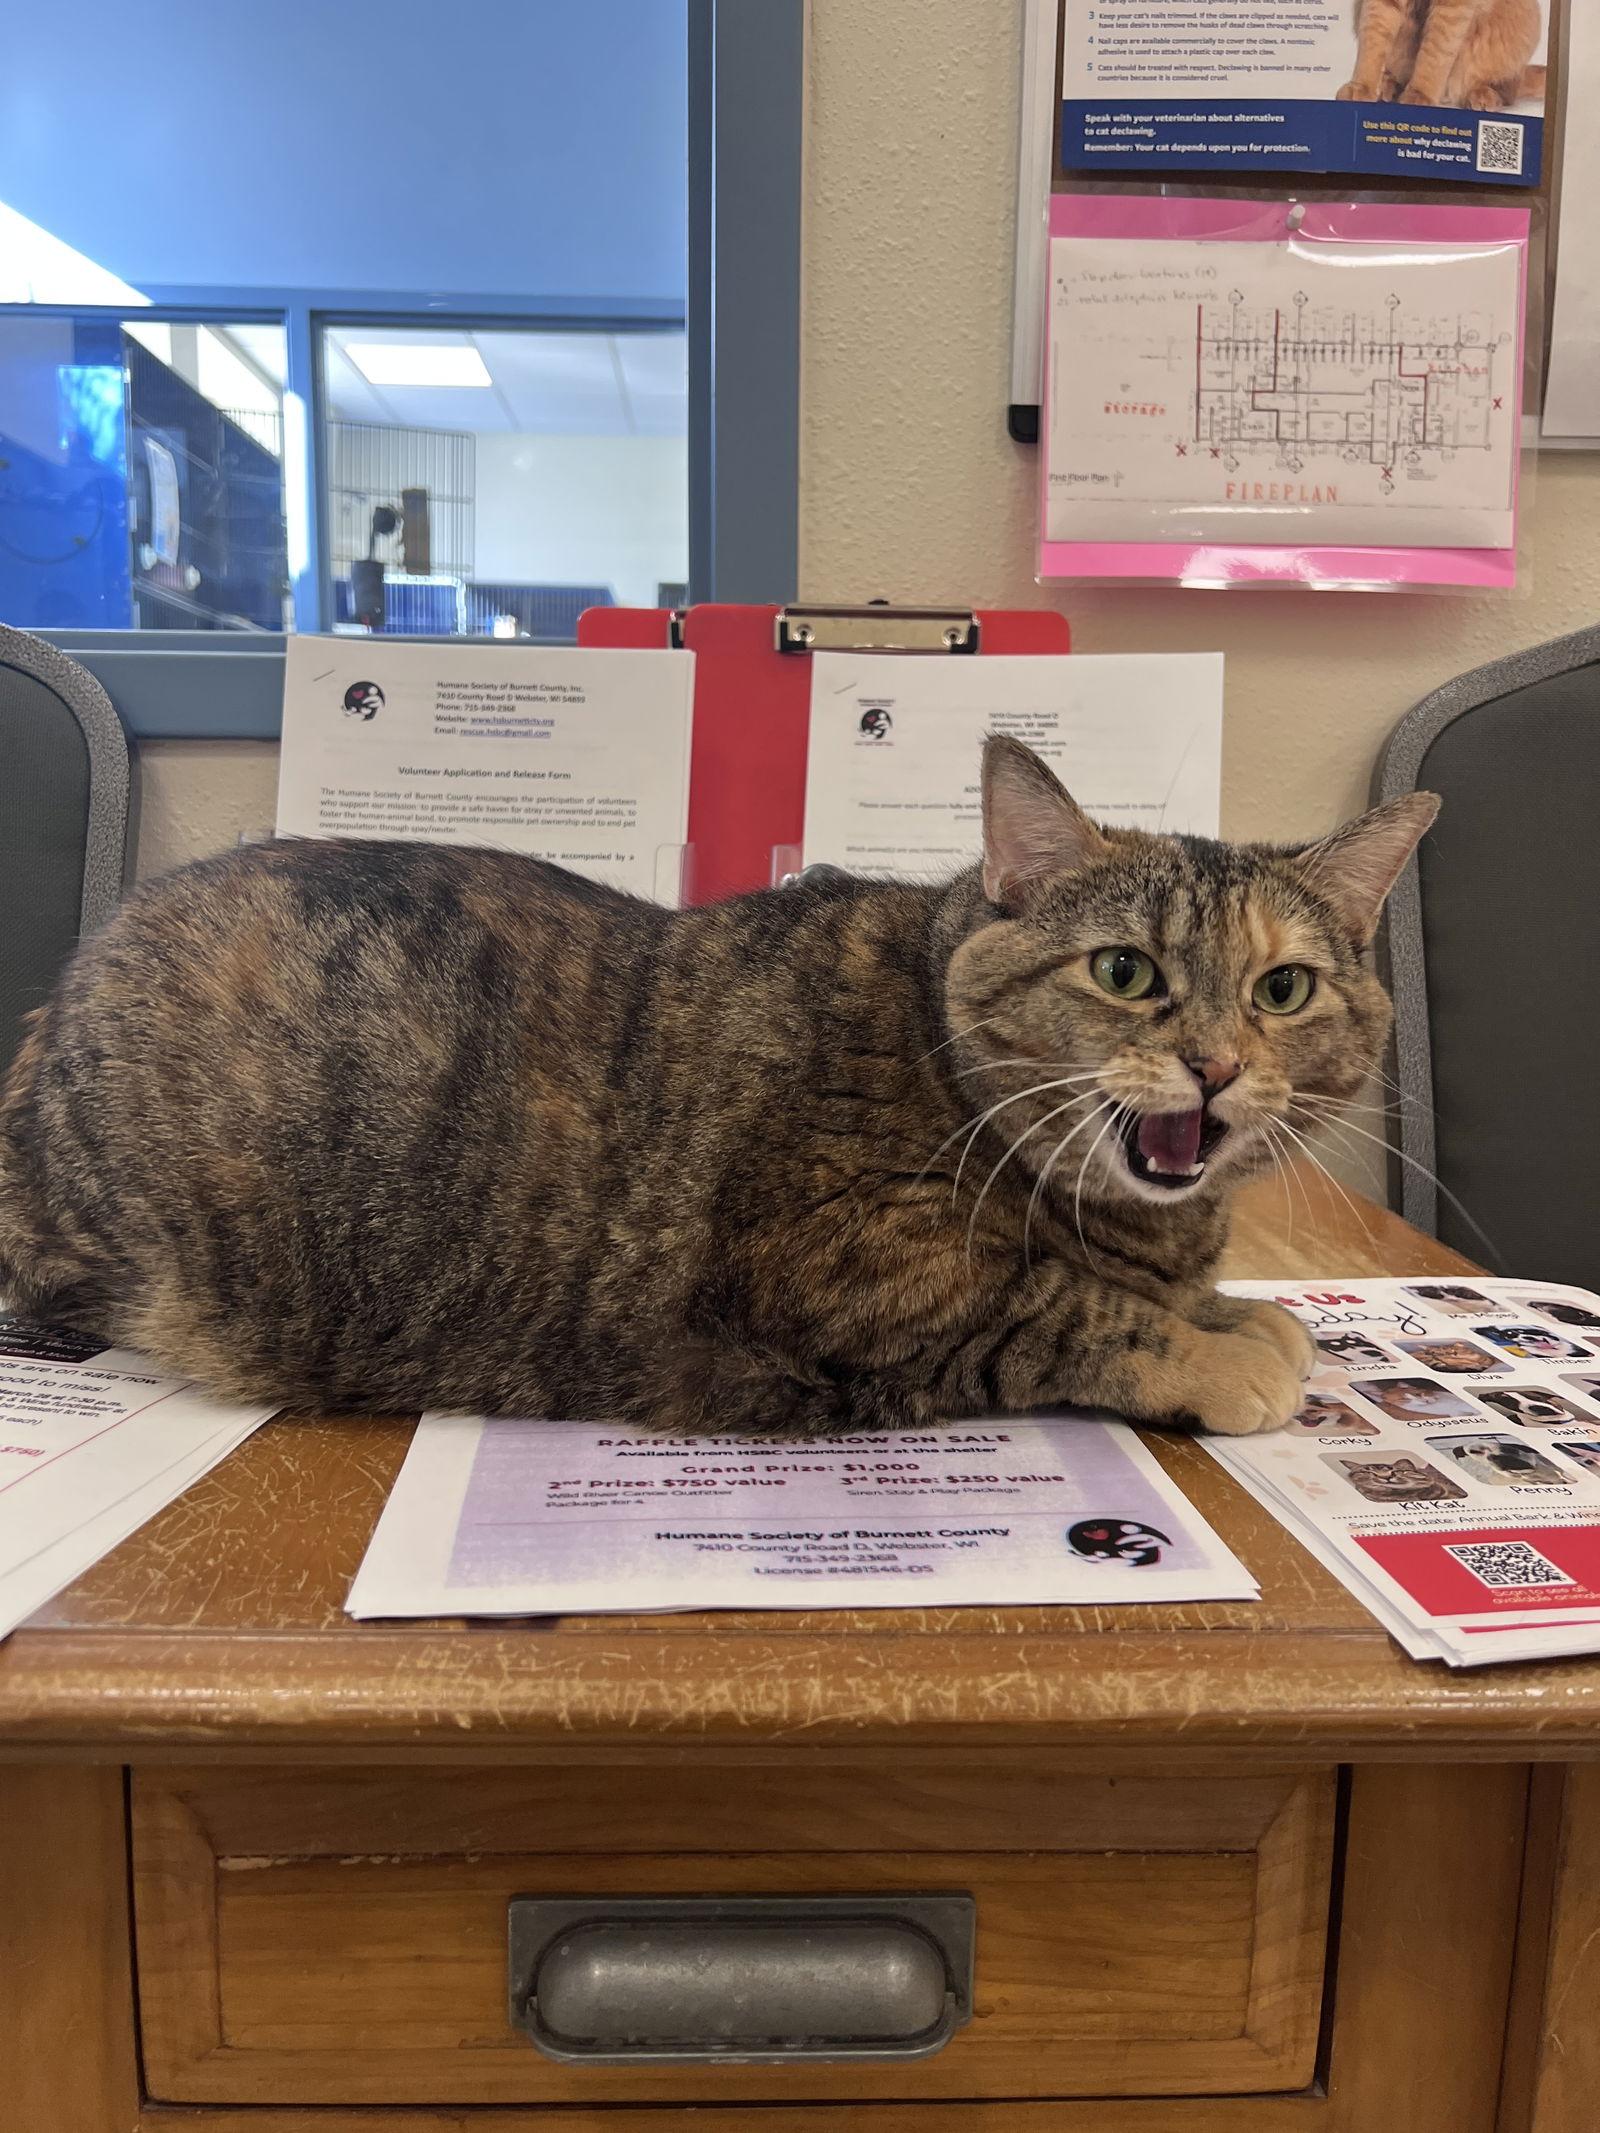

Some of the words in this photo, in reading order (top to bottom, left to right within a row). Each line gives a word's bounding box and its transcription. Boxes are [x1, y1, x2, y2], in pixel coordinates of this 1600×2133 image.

[1190, 65, 1216, 73] respect.
[1085, 115, 1111, 124] Speak
[1134, 116, 1153, 124] your
[1111, 128, 1156, 137] declawing.
[1363, 121, 1378, 129] Use
[1380, 122, 1395, 130] this
[1397, 123, 1409, 132] QR
[1411, 124, 1430, 133] code
[1442, 126, 1457, 135] find
[1459, 129, 1472, 137] out
[1366, 135, 1387, 143] more
[1390, 136, 1412, 144] about
[1414, 138, 1430, 148] why
[1432, 138, 1471, 151] declawing
[1171, 144, 1206, 153] depends
[1264, 145, 1310, 154] protection.
[1398, 149, 1405, 157] is
[1407, 150, 1421, 158] bad
[1423, 151, 1435, 159] for
[1436, 154, 1454, 162] your
[471, 683, 498, 691] Society
[540, 684, 570, 693] County,
[443, 769, 492, 778] Application
[514, 770, 546, 778] Release
[1303, 1292, 1366, 1305] Us
[1302, 1300, 1428, 1336] oday!
[1340, 1365, 1399, 1373] Tundra
[81, 1371, 119, 1380] sale
[122, 1376, 161, 1384] now
[59, 1382, 111, 1392] miss!
[15, 1404, 64, 1414] present
[1406, 1417, 1489, 1429] Odysseus
[828, 1436, 889, 1444] NOW
[900, 1435, 937, 1443] ON
[949, 1434, 1012, 1443] SALE
[1318, 1437, 1372, 1450] Corky
[682, 1465, 754, 1474] Grand
[765, 1464, 834, 1473] Prize:
[843, 1463, 920, 1473] $1,000
[548, 1480, 581, 1490] 2nd
[590, 1479, 654, 1488] Prize:
[662, 1478, 717, 1488] $750
[724, 1478, 787, 1486] value
[840, 1476, 868, 1486] 3rd
[876, 1475, 941, 1485] Prize:
[945, 1474, 999, 1483] $250
[1006, 1474, 1065, 1483] value
[931, 1488, 960, 1496] Play
[963, 1487, 1021, 1495] Package
[1509, 1485, 1573, 1496] Penny
[546, 1500, 607, 1508] Package
[1398, 1501, 1430, 1512] Kit
[1432, 1500, 1466, 1510] Kat
[1349, 1521, 1386, 1530] Save
[1389, 1520, 1415, 1528] the
[1459, 1514, 1510, 1523] Annual
[1513, 1512, 1549, 1521] Bark
[655, 1532, 743, 1540] Humane
[748, 1531, 829, 1541] Society
[832, 1531, 850, 1539] of
[855, 1530, 933, 1538] Burnett
[939, 1528, 1010, 1537] County
[736, 1544, 800, 1554] County
[804, 1543, 849, 1551] Road
[853, 1543, 872, 1551] D,
[876, 1541, 952, 1550] Webster,
[754, 1566, 823, 1575] License
